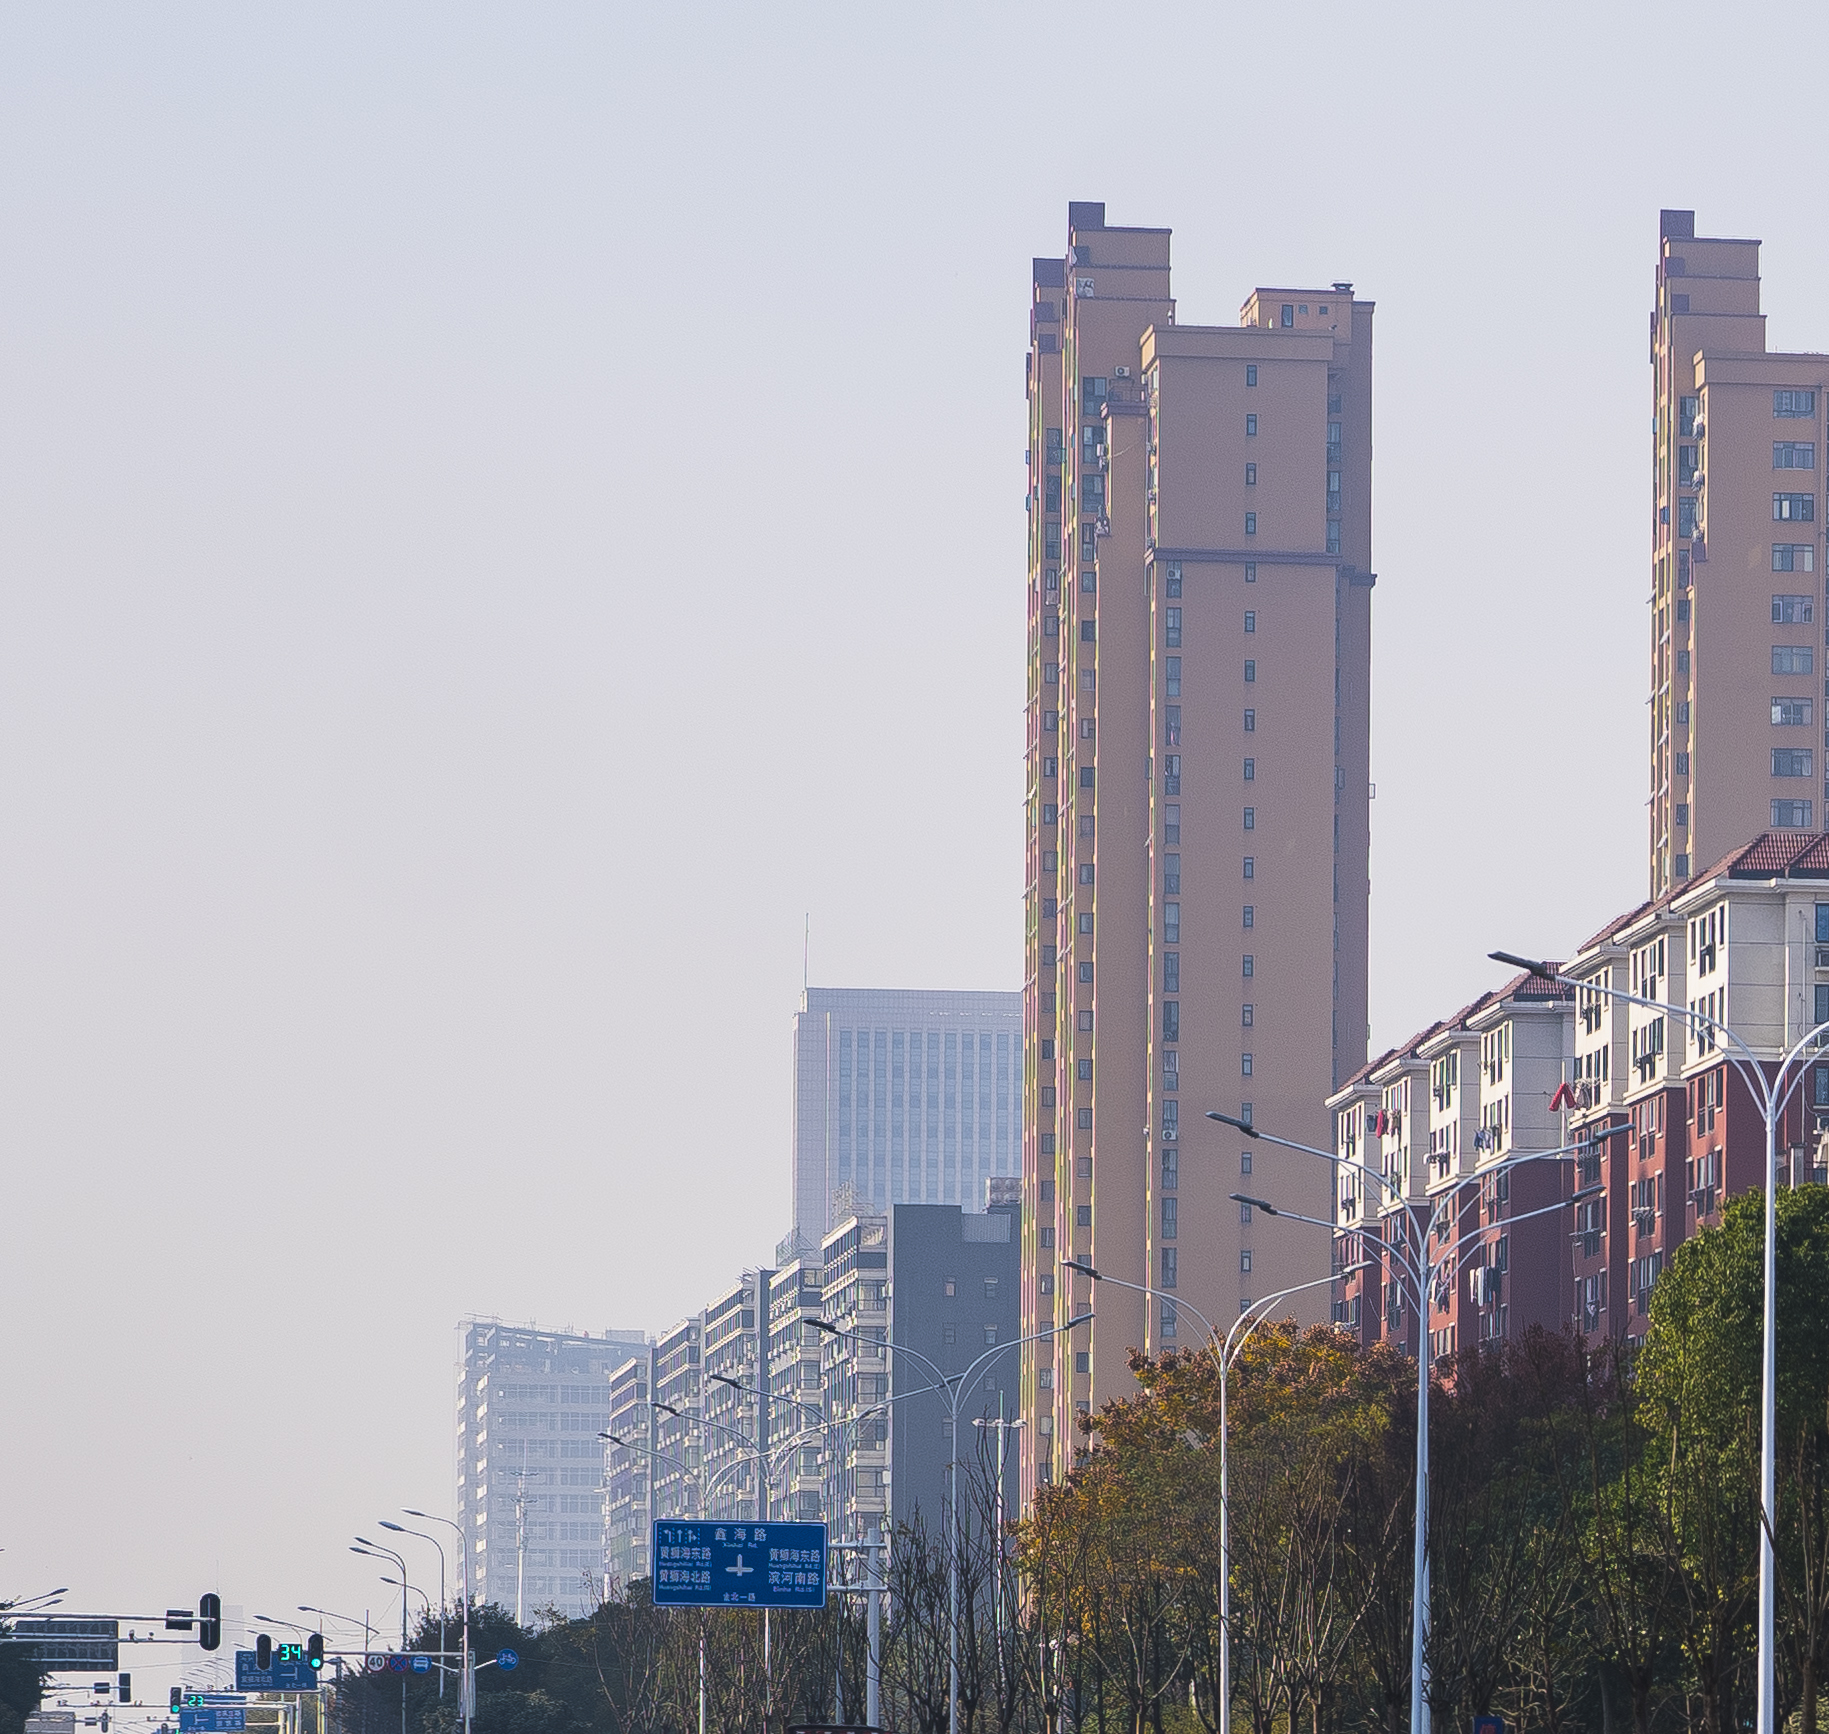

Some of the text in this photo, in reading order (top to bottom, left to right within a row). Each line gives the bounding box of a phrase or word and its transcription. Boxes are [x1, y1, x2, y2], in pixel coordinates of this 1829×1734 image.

[660, 1546, 711, 1560] 黄狮海东路
[769, 1548, 821, 1562] 黄狮海东路
[660, 1570, 710, 1583] 黄狮海北路
[769, 1571, 820, 1585] 滨河南路
[281, 1644, 301, 1660] 34
[370, 1656, 383, 1666] 40
[188, 1696, 204, 1706] 23
